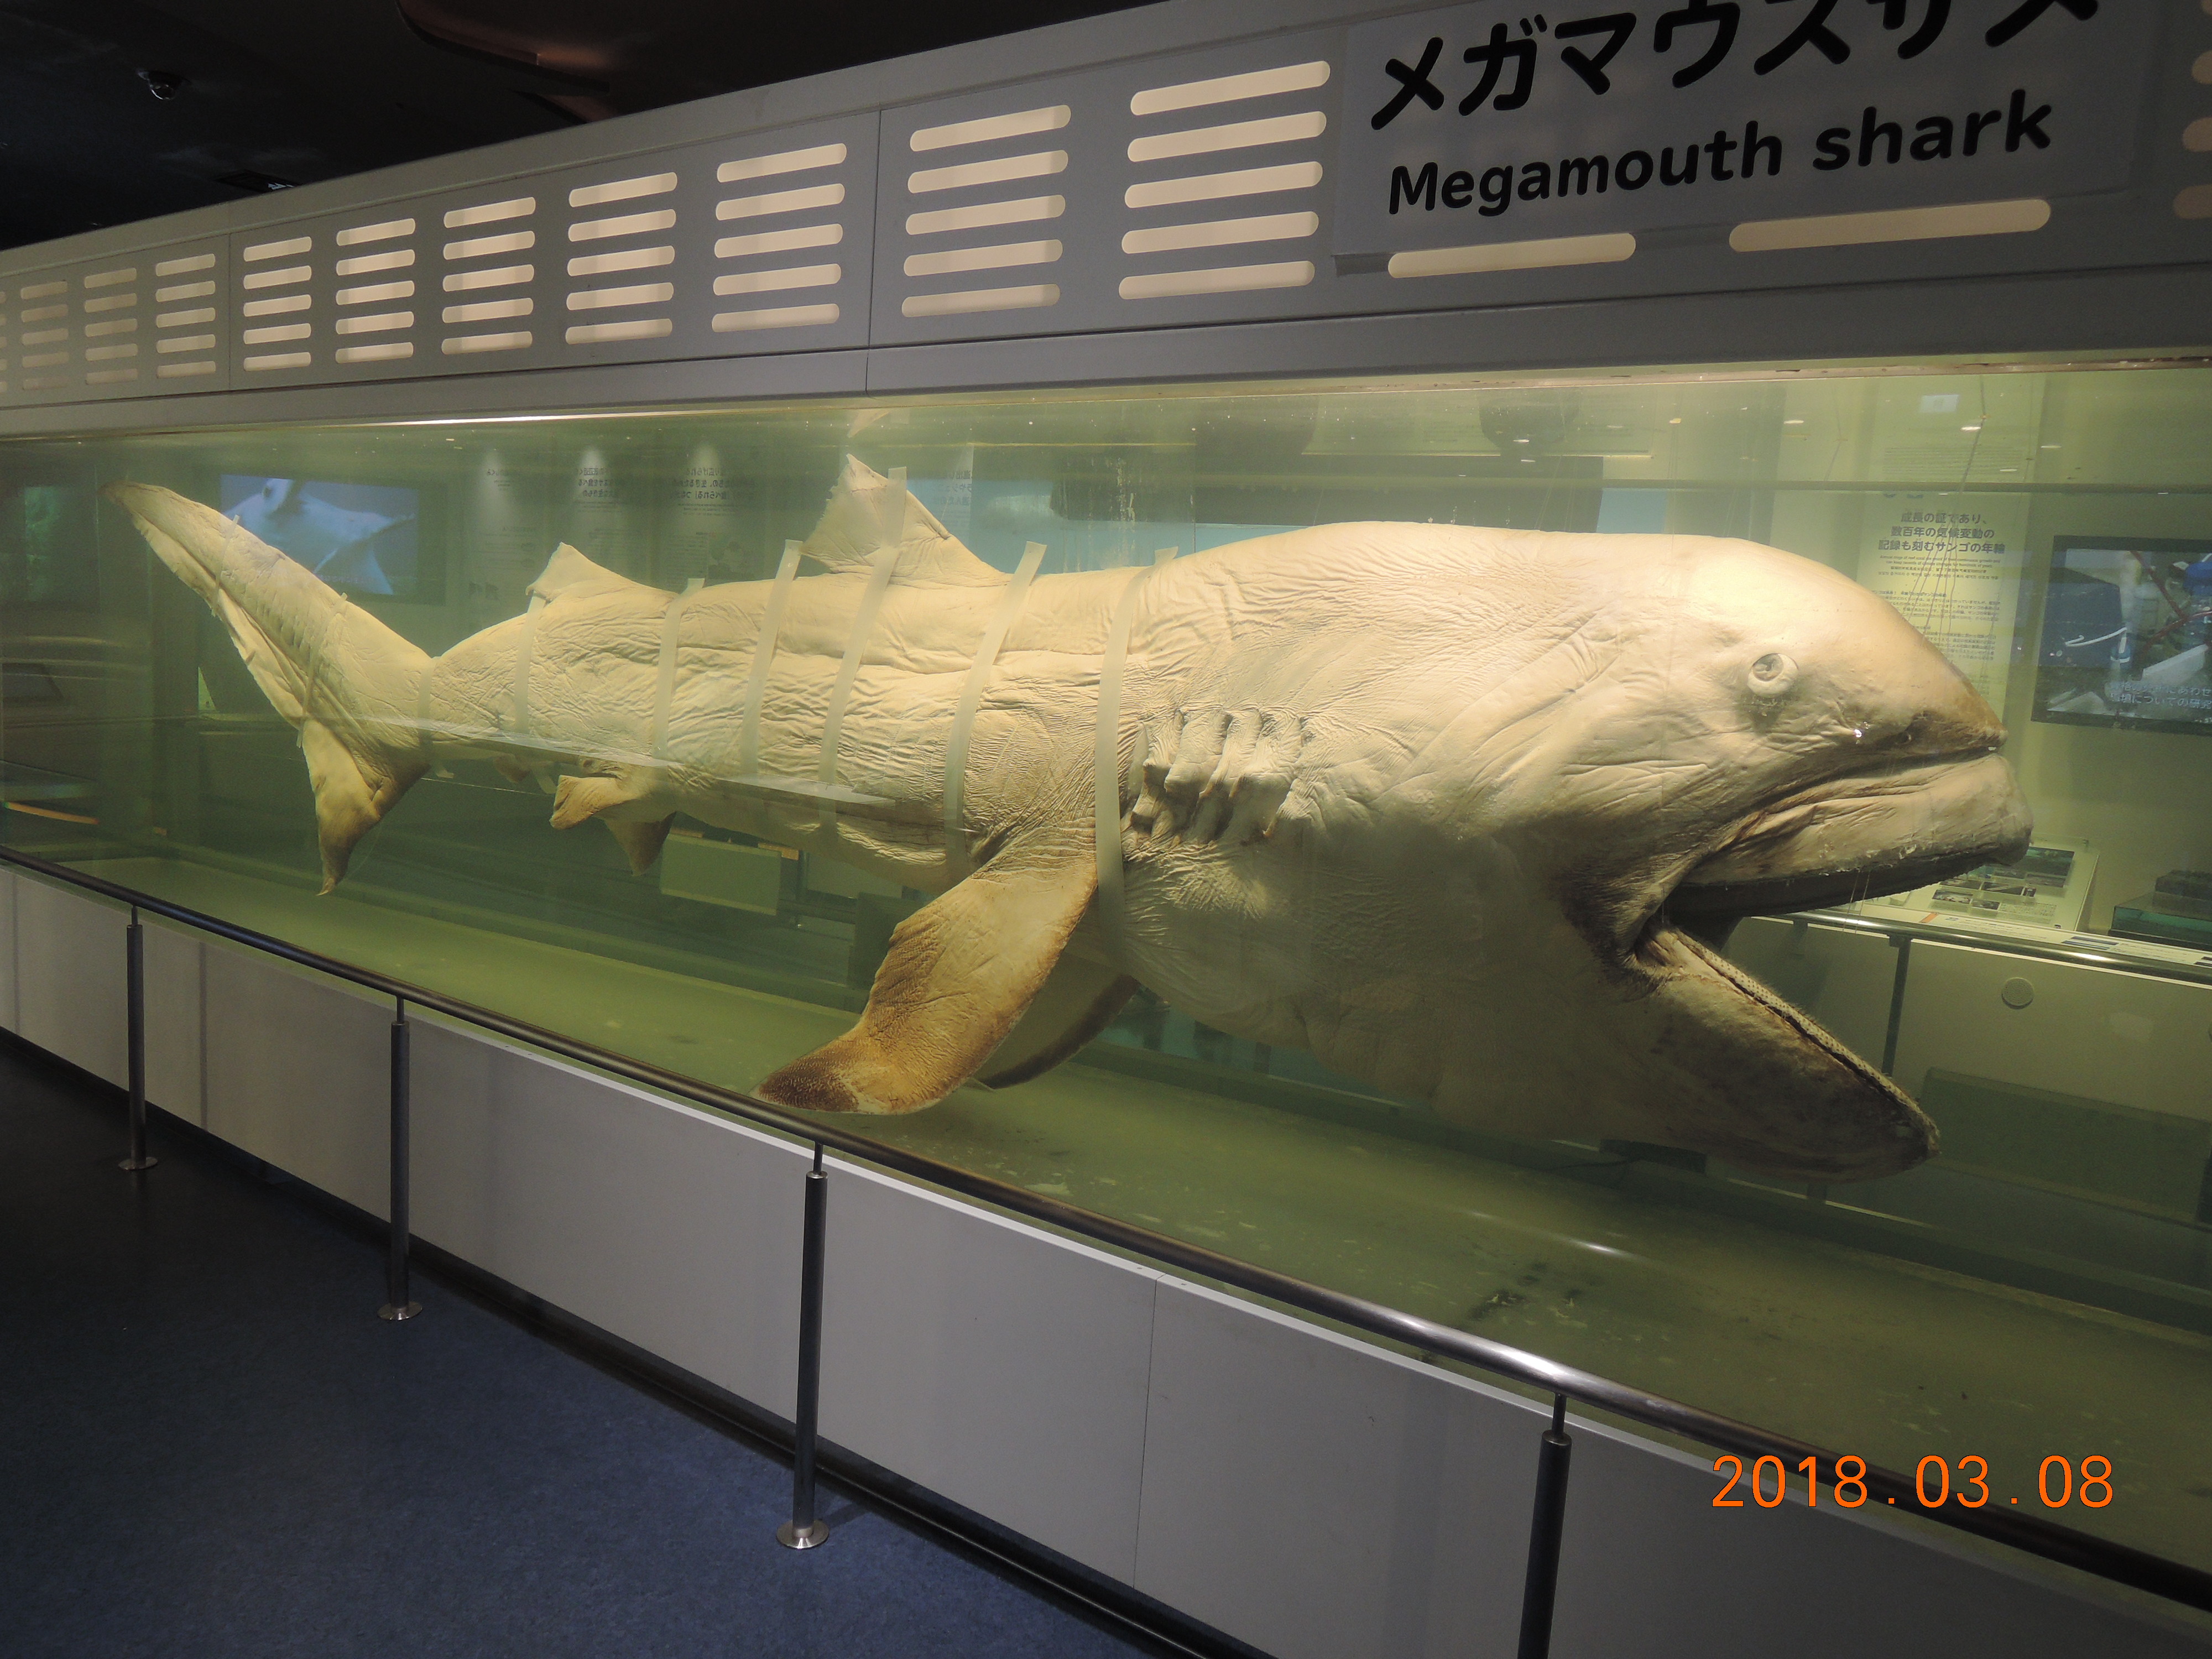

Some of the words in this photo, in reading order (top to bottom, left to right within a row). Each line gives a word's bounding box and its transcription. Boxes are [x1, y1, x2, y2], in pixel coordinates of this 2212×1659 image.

[1389, 121, 1782, 217] Megamouth
[1812, 89, 2052, 171] shark
[1901, 512, 1987, 524] 成長の証であり、
[1891, 526, 1995, 539] 数百年の気候変動の
[1878, 539, 2006, 554] 記録も刻むサンゴの年輪
